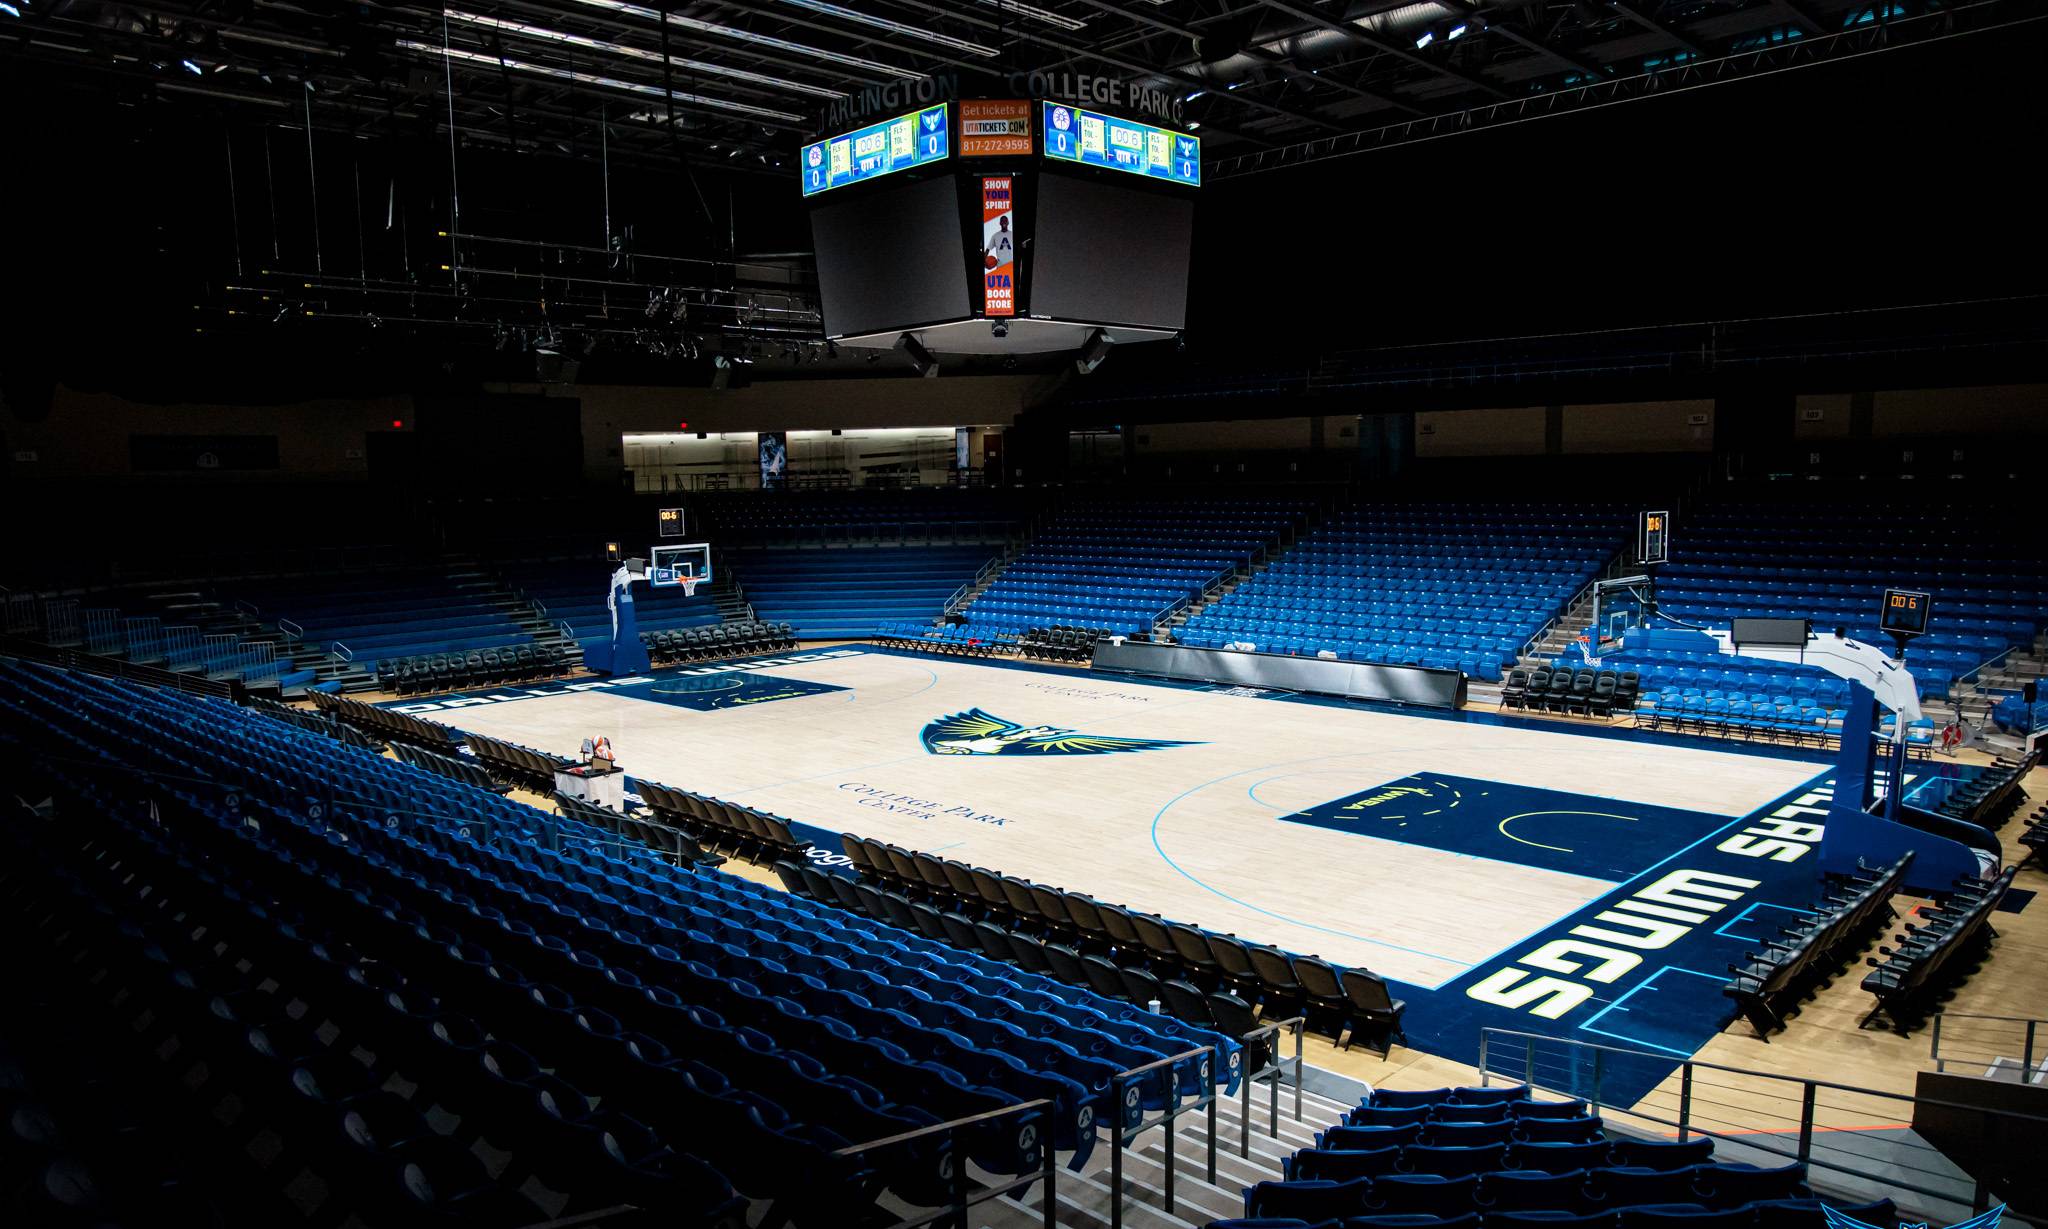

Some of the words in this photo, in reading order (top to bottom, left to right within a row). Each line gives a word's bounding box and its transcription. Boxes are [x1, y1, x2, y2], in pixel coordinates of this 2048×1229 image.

[828, 73, 960, 127] ARLINGTON
[1008, 71, 1121, 105] COLLEGE
[1130, 82, 1170, 119] PARK
[963, 105, 979, 116] Get
[982, 104, 1015, 115] tickets
[1019, 105, 1028, 115] at
[929, 136, 938, 154] 0
[963, 139, 1029, 151] 817-272-9595
[1057, 133, 1066, 152] 0
[1184, 161, 1191, 177] 0
[812, 170, 820, 187] 0
[985, 180, 1010, 189] SHOW
[986, 190, 1010, 199] YOUR
[985, 200, 1010, 209] SPIRIT
[987, 275, 1011, 288] UTA
[987, 289, 1011, 299] BOOK
[987, 300, 1011, 309] STORE
[678, 649, 865, 676] WINGS
[389, 676, 656, 713] DALLAS
[839, 782, 944, 809] COLLEGE
[944, 805, 1016, 827] PARK
[1341, 789, 1410, 811] WNBA
[858, 798, 936, 821] CENTER
[1466, 868, 1763, 1021] WINGS
